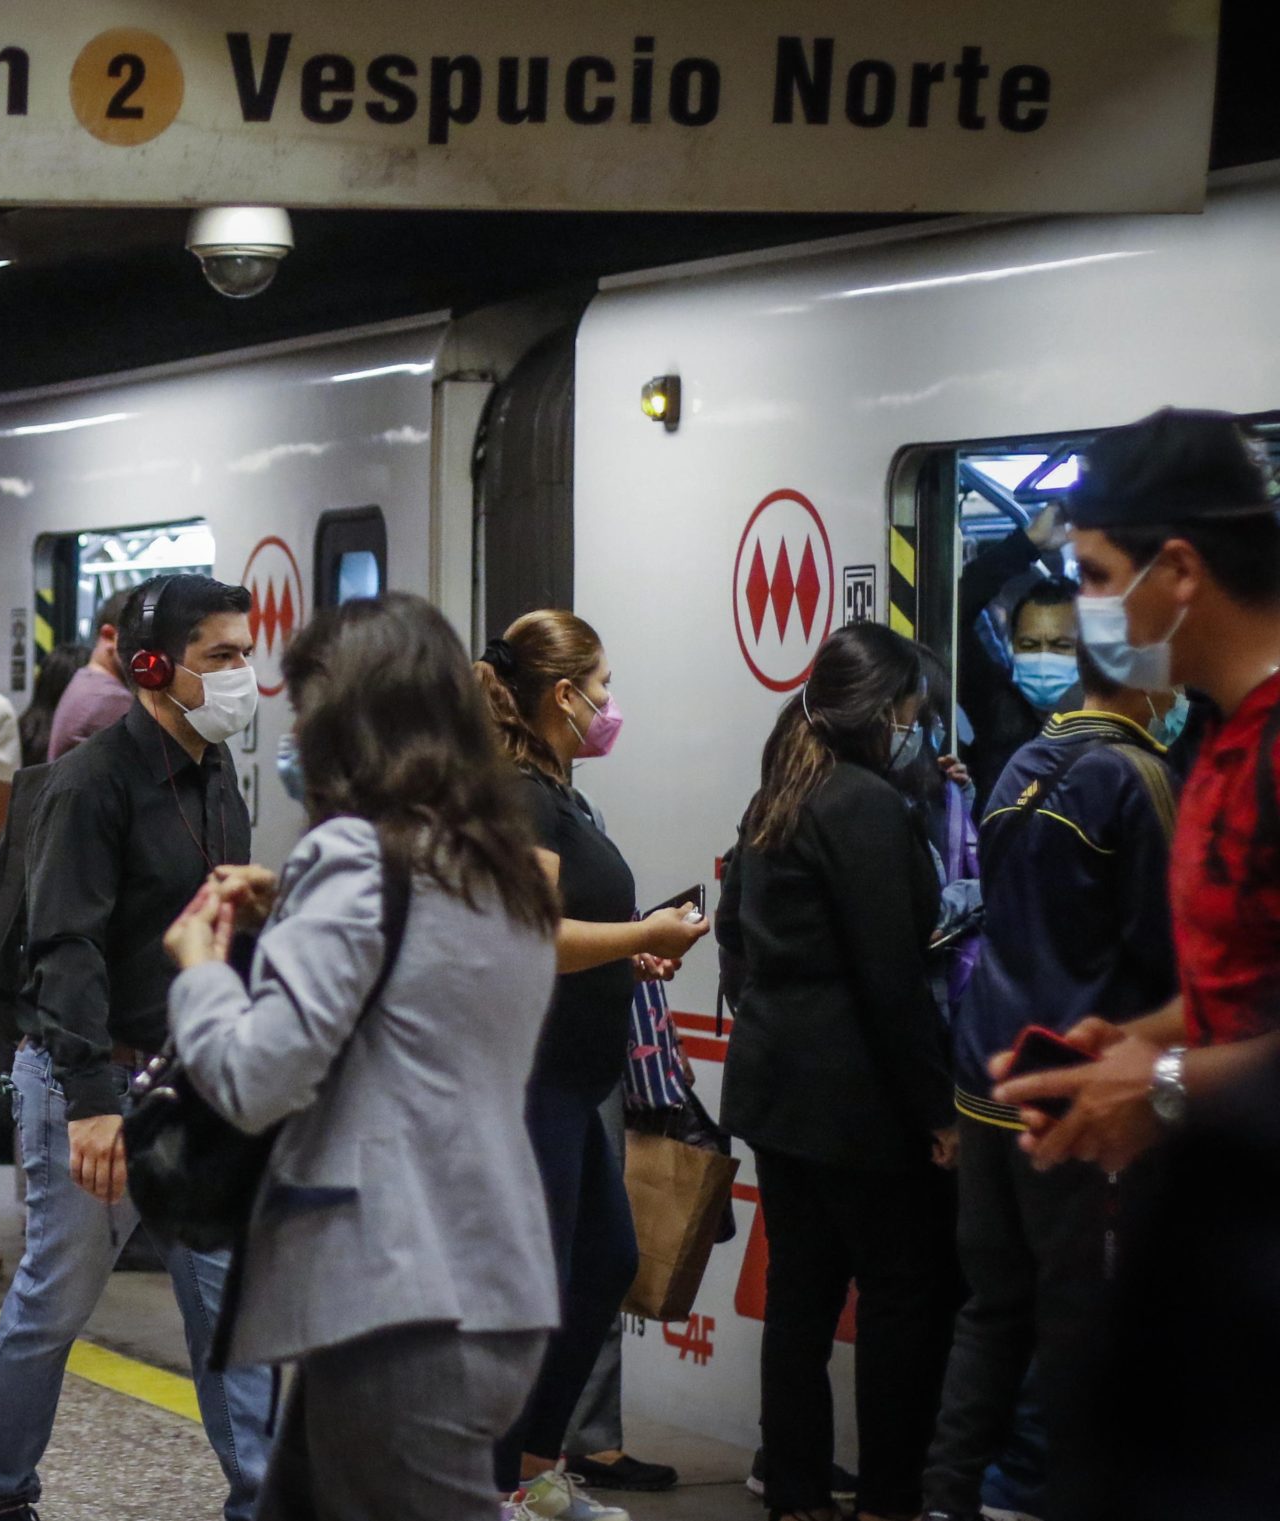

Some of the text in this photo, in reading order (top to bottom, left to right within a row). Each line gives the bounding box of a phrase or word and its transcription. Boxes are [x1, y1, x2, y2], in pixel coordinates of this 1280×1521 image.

[106, 52, 147, 120] 2
[226, 32, 722, 146] Vespucio
[773, 36, 1052, 134] Norte
